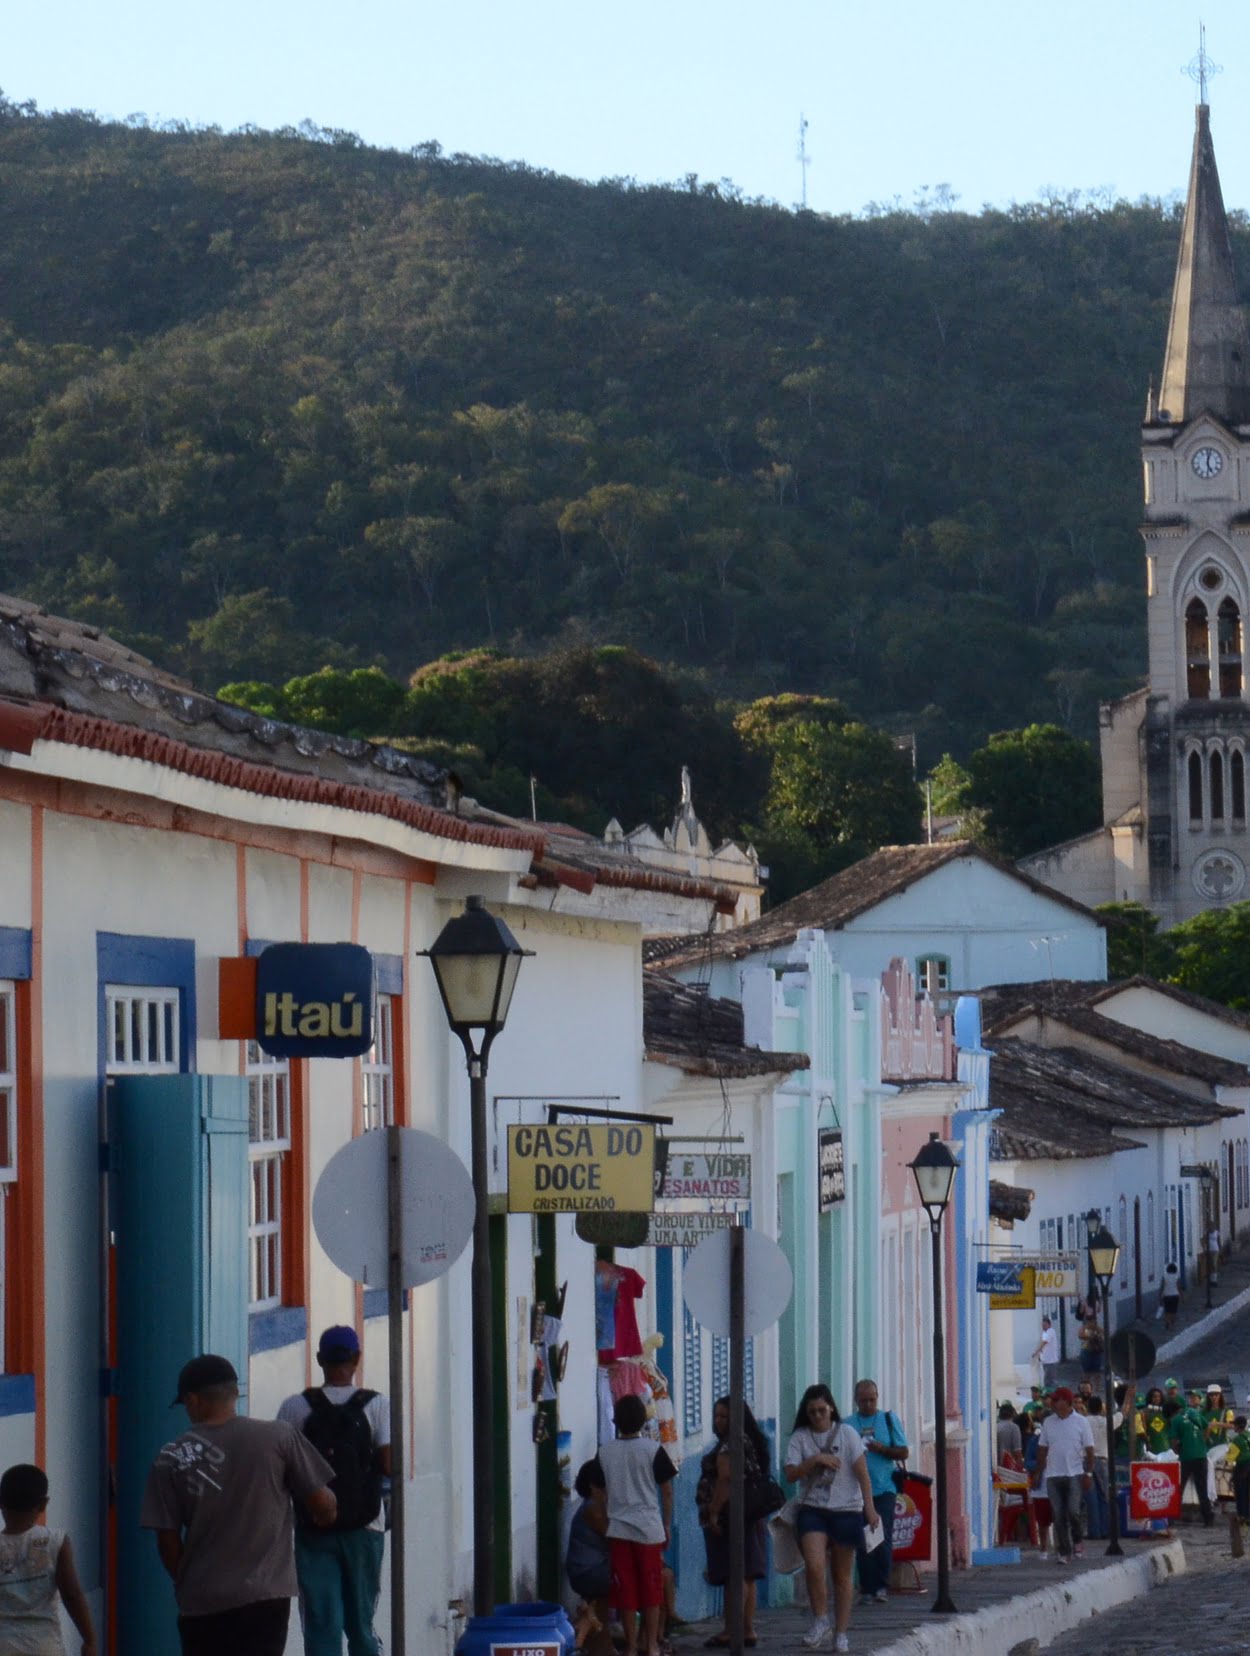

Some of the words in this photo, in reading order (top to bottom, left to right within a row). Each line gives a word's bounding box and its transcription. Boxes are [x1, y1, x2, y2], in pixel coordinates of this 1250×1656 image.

[265, 992, 363, 1037] Itaú
[514, 1127, 594, 1157] CASA
[607, 1127, 643, 1157] DO
[534, 1163, 601, 1191] DOCE
[705, 1157, 746, 1177] VIDA
[664, 1180, 740, 1195] ESANATOS
[533, 1197, 616, 1210] CRISTALIZADO
[655, 1230, 679, 1244] UMA
[683, 1230, 714, 1244] ART
